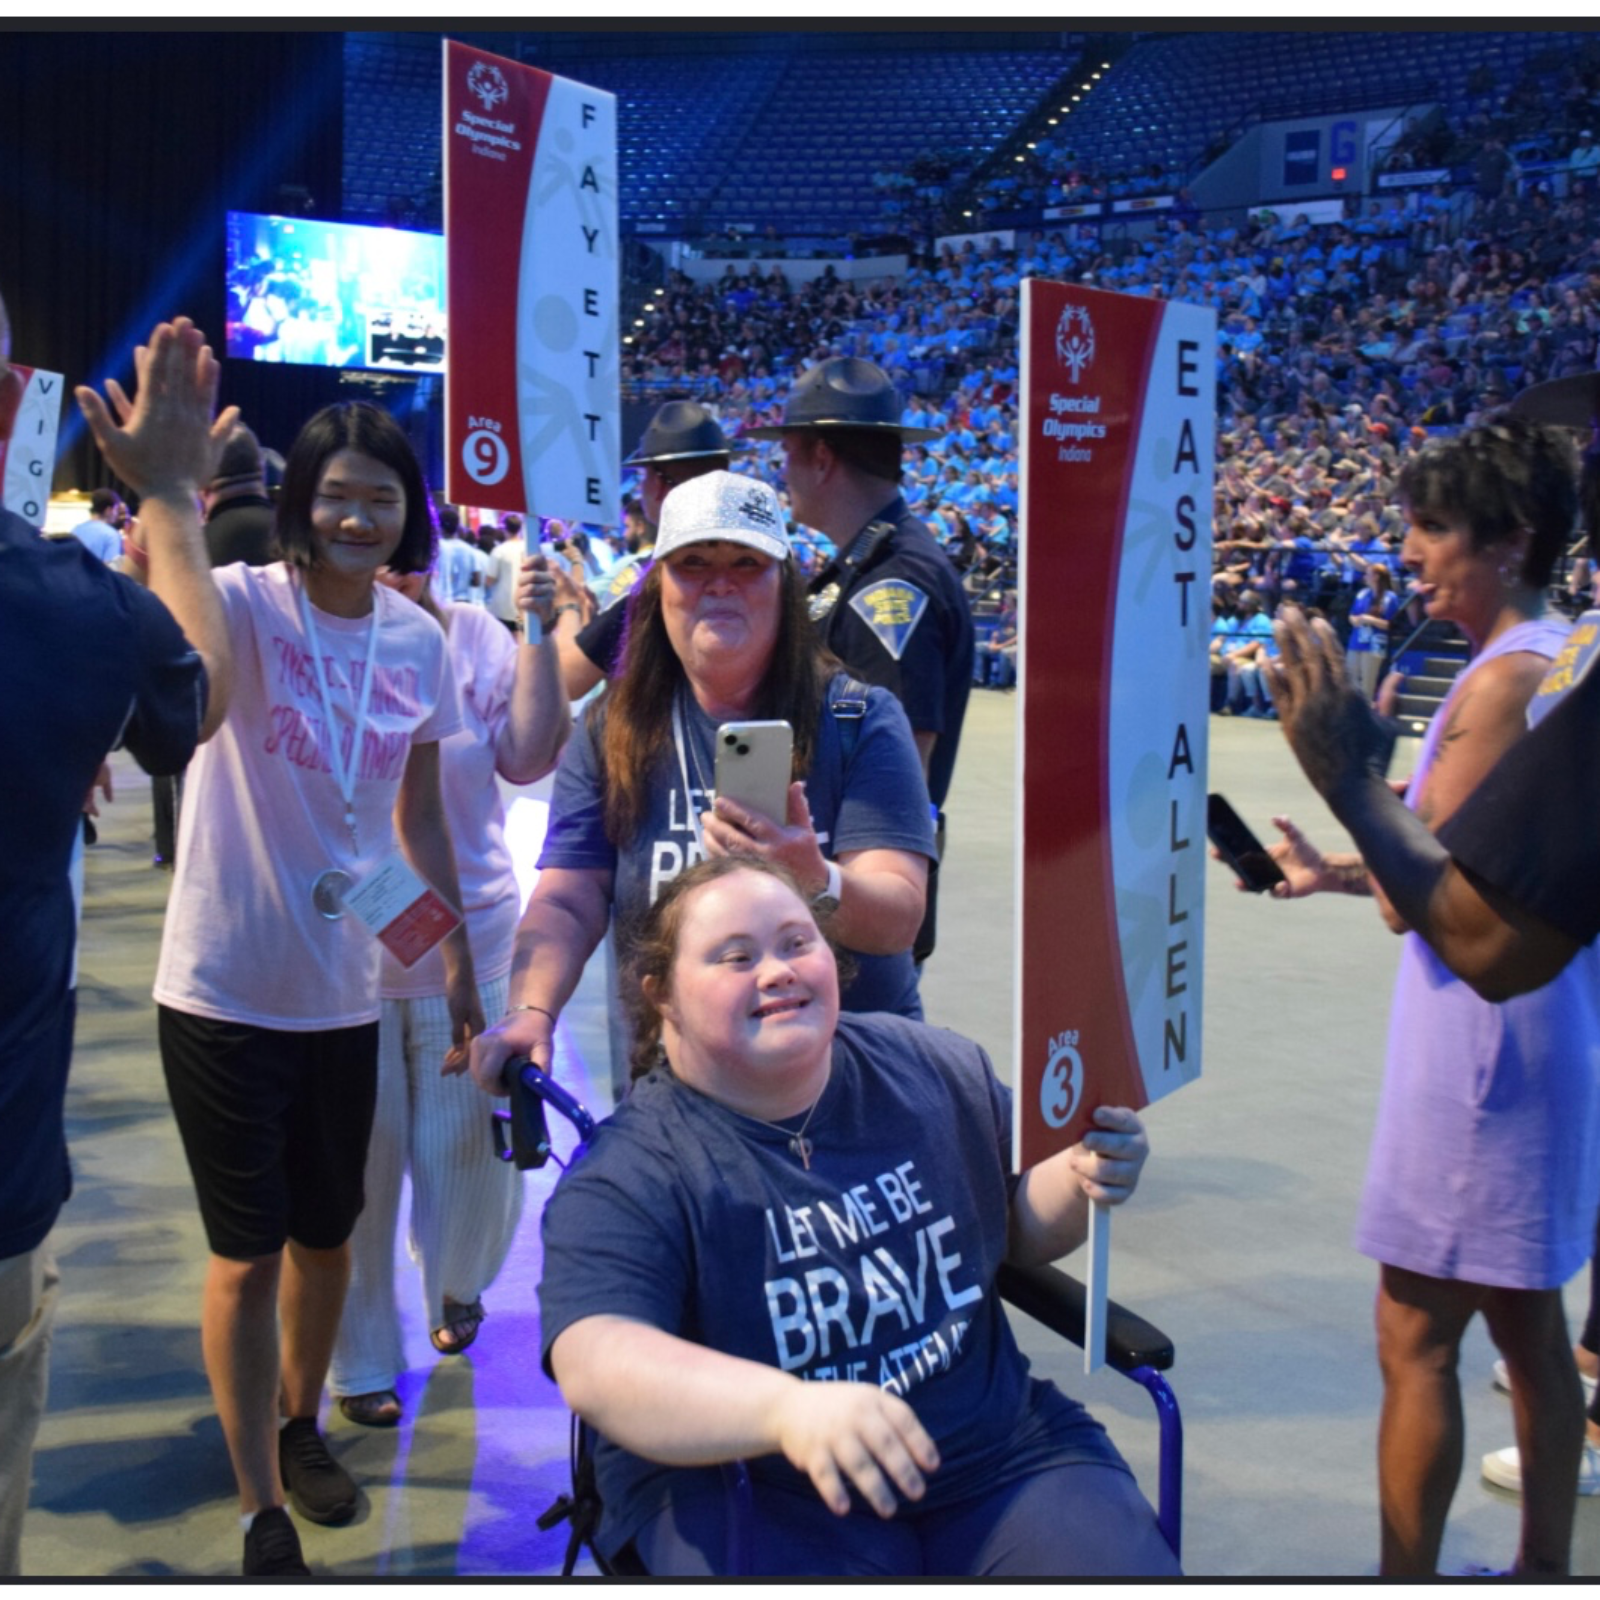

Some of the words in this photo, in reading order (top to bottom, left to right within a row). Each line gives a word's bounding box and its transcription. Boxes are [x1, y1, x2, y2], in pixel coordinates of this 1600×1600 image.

[455, 123, 521, 150] Olympics
[462, 110, 515, 134] Special
[580, 103, 602, 505] FAYETTE
[468, 415, 502, 432] Area
[1042, 418, 1106, 441] Olympics
[1049, 393, 1101, 415] Special
[23, 378, 53, 518] VIGO
[473, 436, 499, 478] 9
[1174, 340, 1199, 627] EAST
[1164, 723, 1194, 1071] ALLEN
[1048, 1029, 1079, 1056] Area
[1051, 1058, 1074, 1120] 3
[766, 1205, 819, 1264] LET
[818, 1184, 890, 1250] ME
[875, 1160, 933, 1224] BE
[764, 1215, 984, 1371] BRAVE
